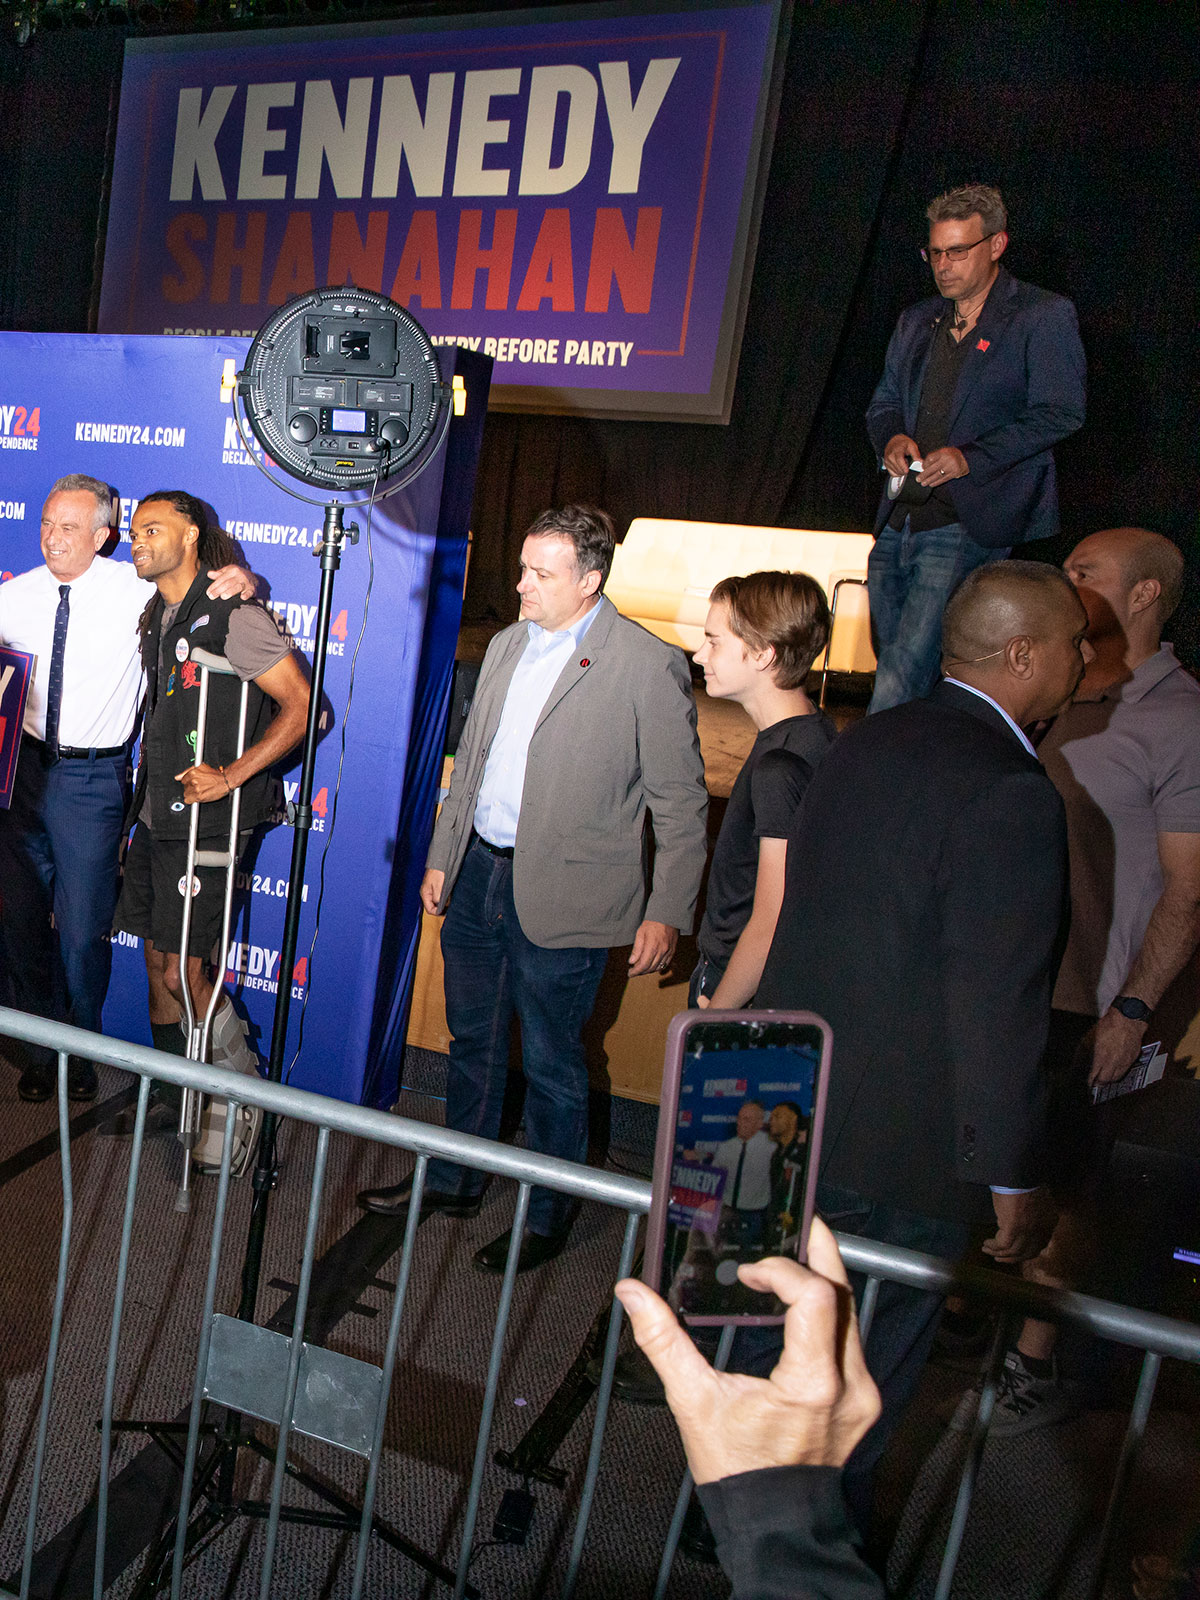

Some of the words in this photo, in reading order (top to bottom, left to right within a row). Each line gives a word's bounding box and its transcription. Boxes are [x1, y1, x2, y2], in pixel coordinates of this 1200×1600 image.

[168, 57, 682, 201] KENNEDY
[161, 206, 663, 314] SHANAHAN
[484, 337, 560, 364] BEFORE
[564, 340, 634, 367] PARTY
[75, 422, 186, 447] KENNEDY24.COM
